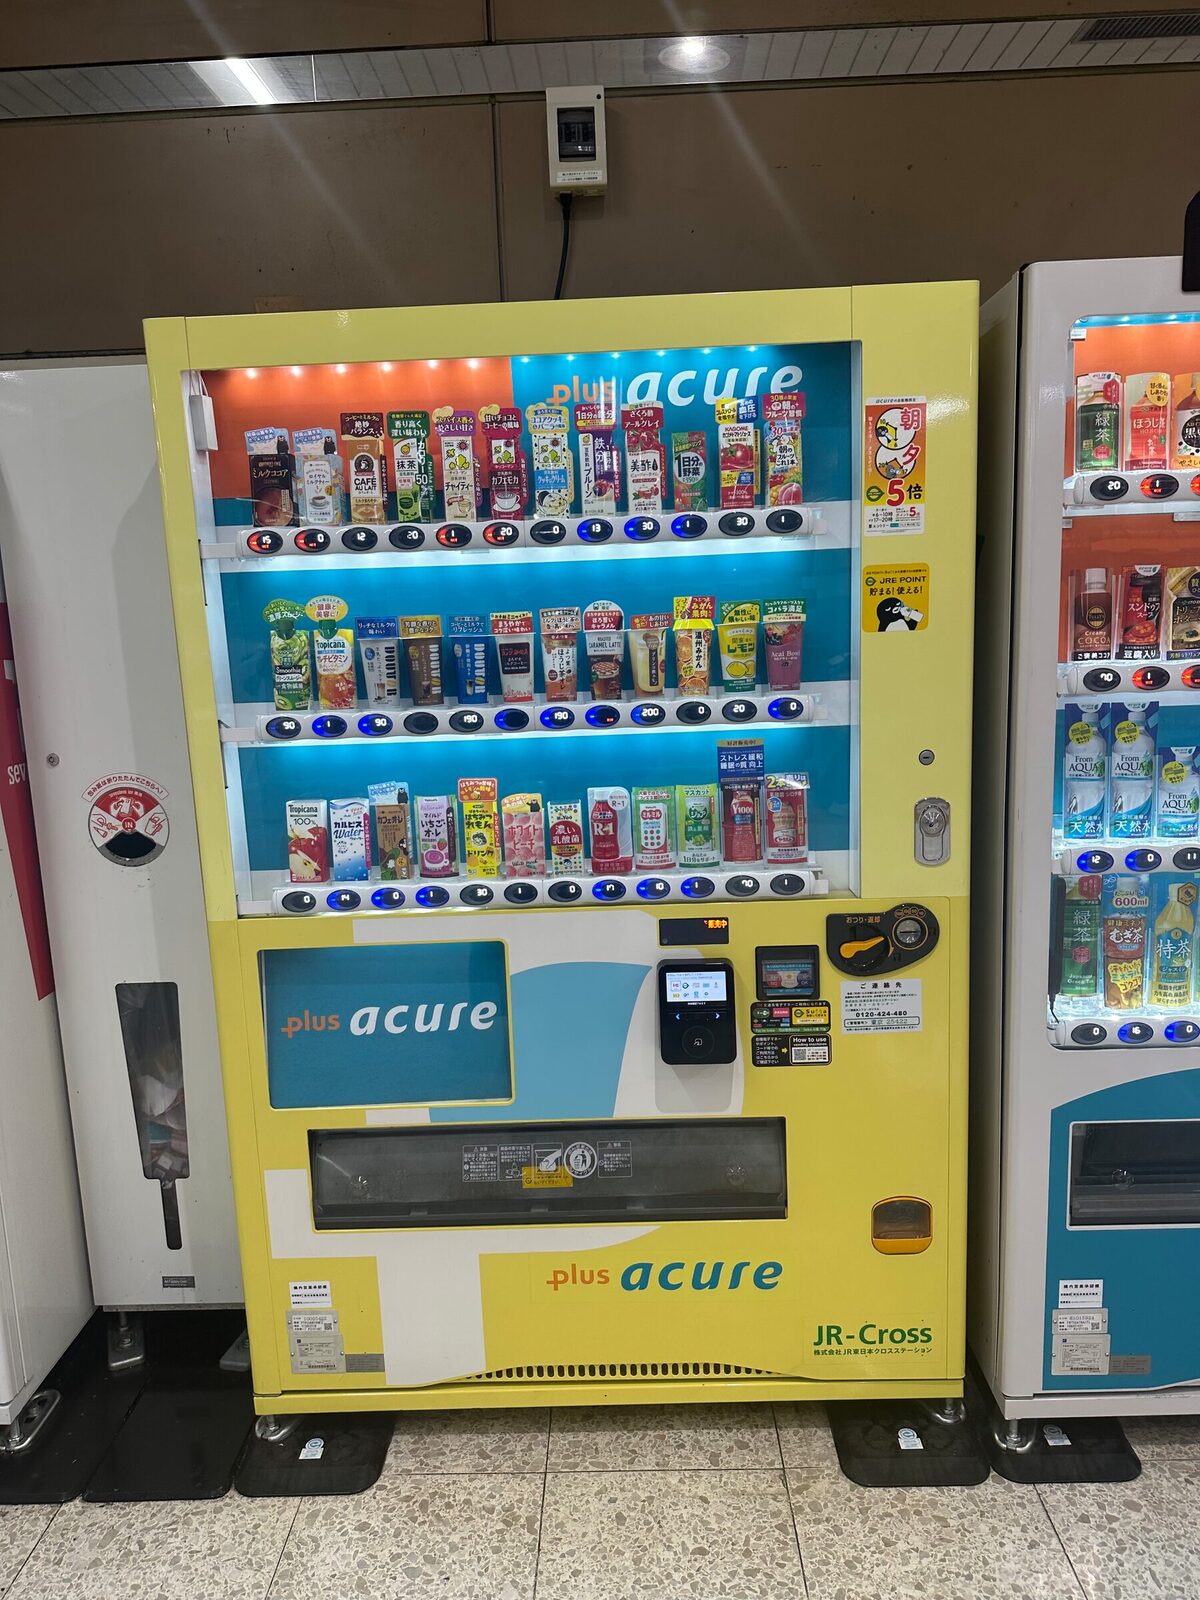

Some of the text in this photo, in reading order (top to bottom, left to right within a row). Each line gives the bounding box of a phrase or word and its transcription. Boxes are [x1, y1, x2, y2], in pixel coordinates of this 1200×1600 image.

[627, 366, 802, 406] acure
[485, 414, 517, 422] 甘いチョコと
[899, 408, 921, 431] 朝
[1133, 417, 1166, 429] ほうじ茶
[394, 420, 422, 428] 香り高く
[624, 419, 660, 428] アールグレイ
[1095, 412, 1110, 442] 緑茶
[350, 425, 374, 434] バランス
[391, 429, 427, 437] 深い味わい
[778, 446, 793, 454] 朝の
[396, 461, 416, 470] 抹茶
[630, 459, 652, 472] 美酢
[252, 467, 288, 478] ミルクココア
[353, 475, 377, 486] CAFÉ
[492, 476, 519, 485] カフェモカ
[584, 467, 593, 498] プルーン
[444, 482, 473, 491] チャイティー
[886, 478, 923, 507] 5 倍
[879, 575, 927, 585] JRE POINT
[869, 585, 923, 597] 貯まる! 使える!
[691, 602, 713, 610] みかん
[1077, 637, 1111, 645] COCOA
[727, 644, 755, 654] レモン
[1075, 755, 1094, 763] From
[1068, 763, 1098, 774] AQUA
[1114, 762, 1145, 773] AQUA
[288, 804, 318, 813] Tropicana
[1161, 800, 1192, 810] AQUA
[293, 817, 317, 825] 100%
[333, 820, 363, 829] カルピス
[508, 824, 539, 835] ホワイト
[555, 825, 576, 834] 濃い
[593, 822, 614, 836] R-1
[1070, 820, 1104, 833] 天然水
[1115, 820, 1151, 833] 天然水
[333, 828, 364, 838] Water
[552, 834, 580, 844] 乳酸菌
[513, 840, 535, 851] ピーチ
[467, 849, 494, 857] ドリンク
[1114, 897, 1149, 906] 600ml
[846, 916, 881, 924] おつり・返却
[1073, 910, 1091, 942] 緑茶
[1109, 927, 1144, 944] むぎ茶
[1155, 938, 1191, 959] 特茶
[860, 981, 902, 989] ご連絡先
[855, 1010, 908, 1018] 0120-424-480
[280, 1001, 498, 1039] plus acure
[546, 1260, 784, 1292] plus acure
[812, 1323, 933, 1346] JR-Cross
